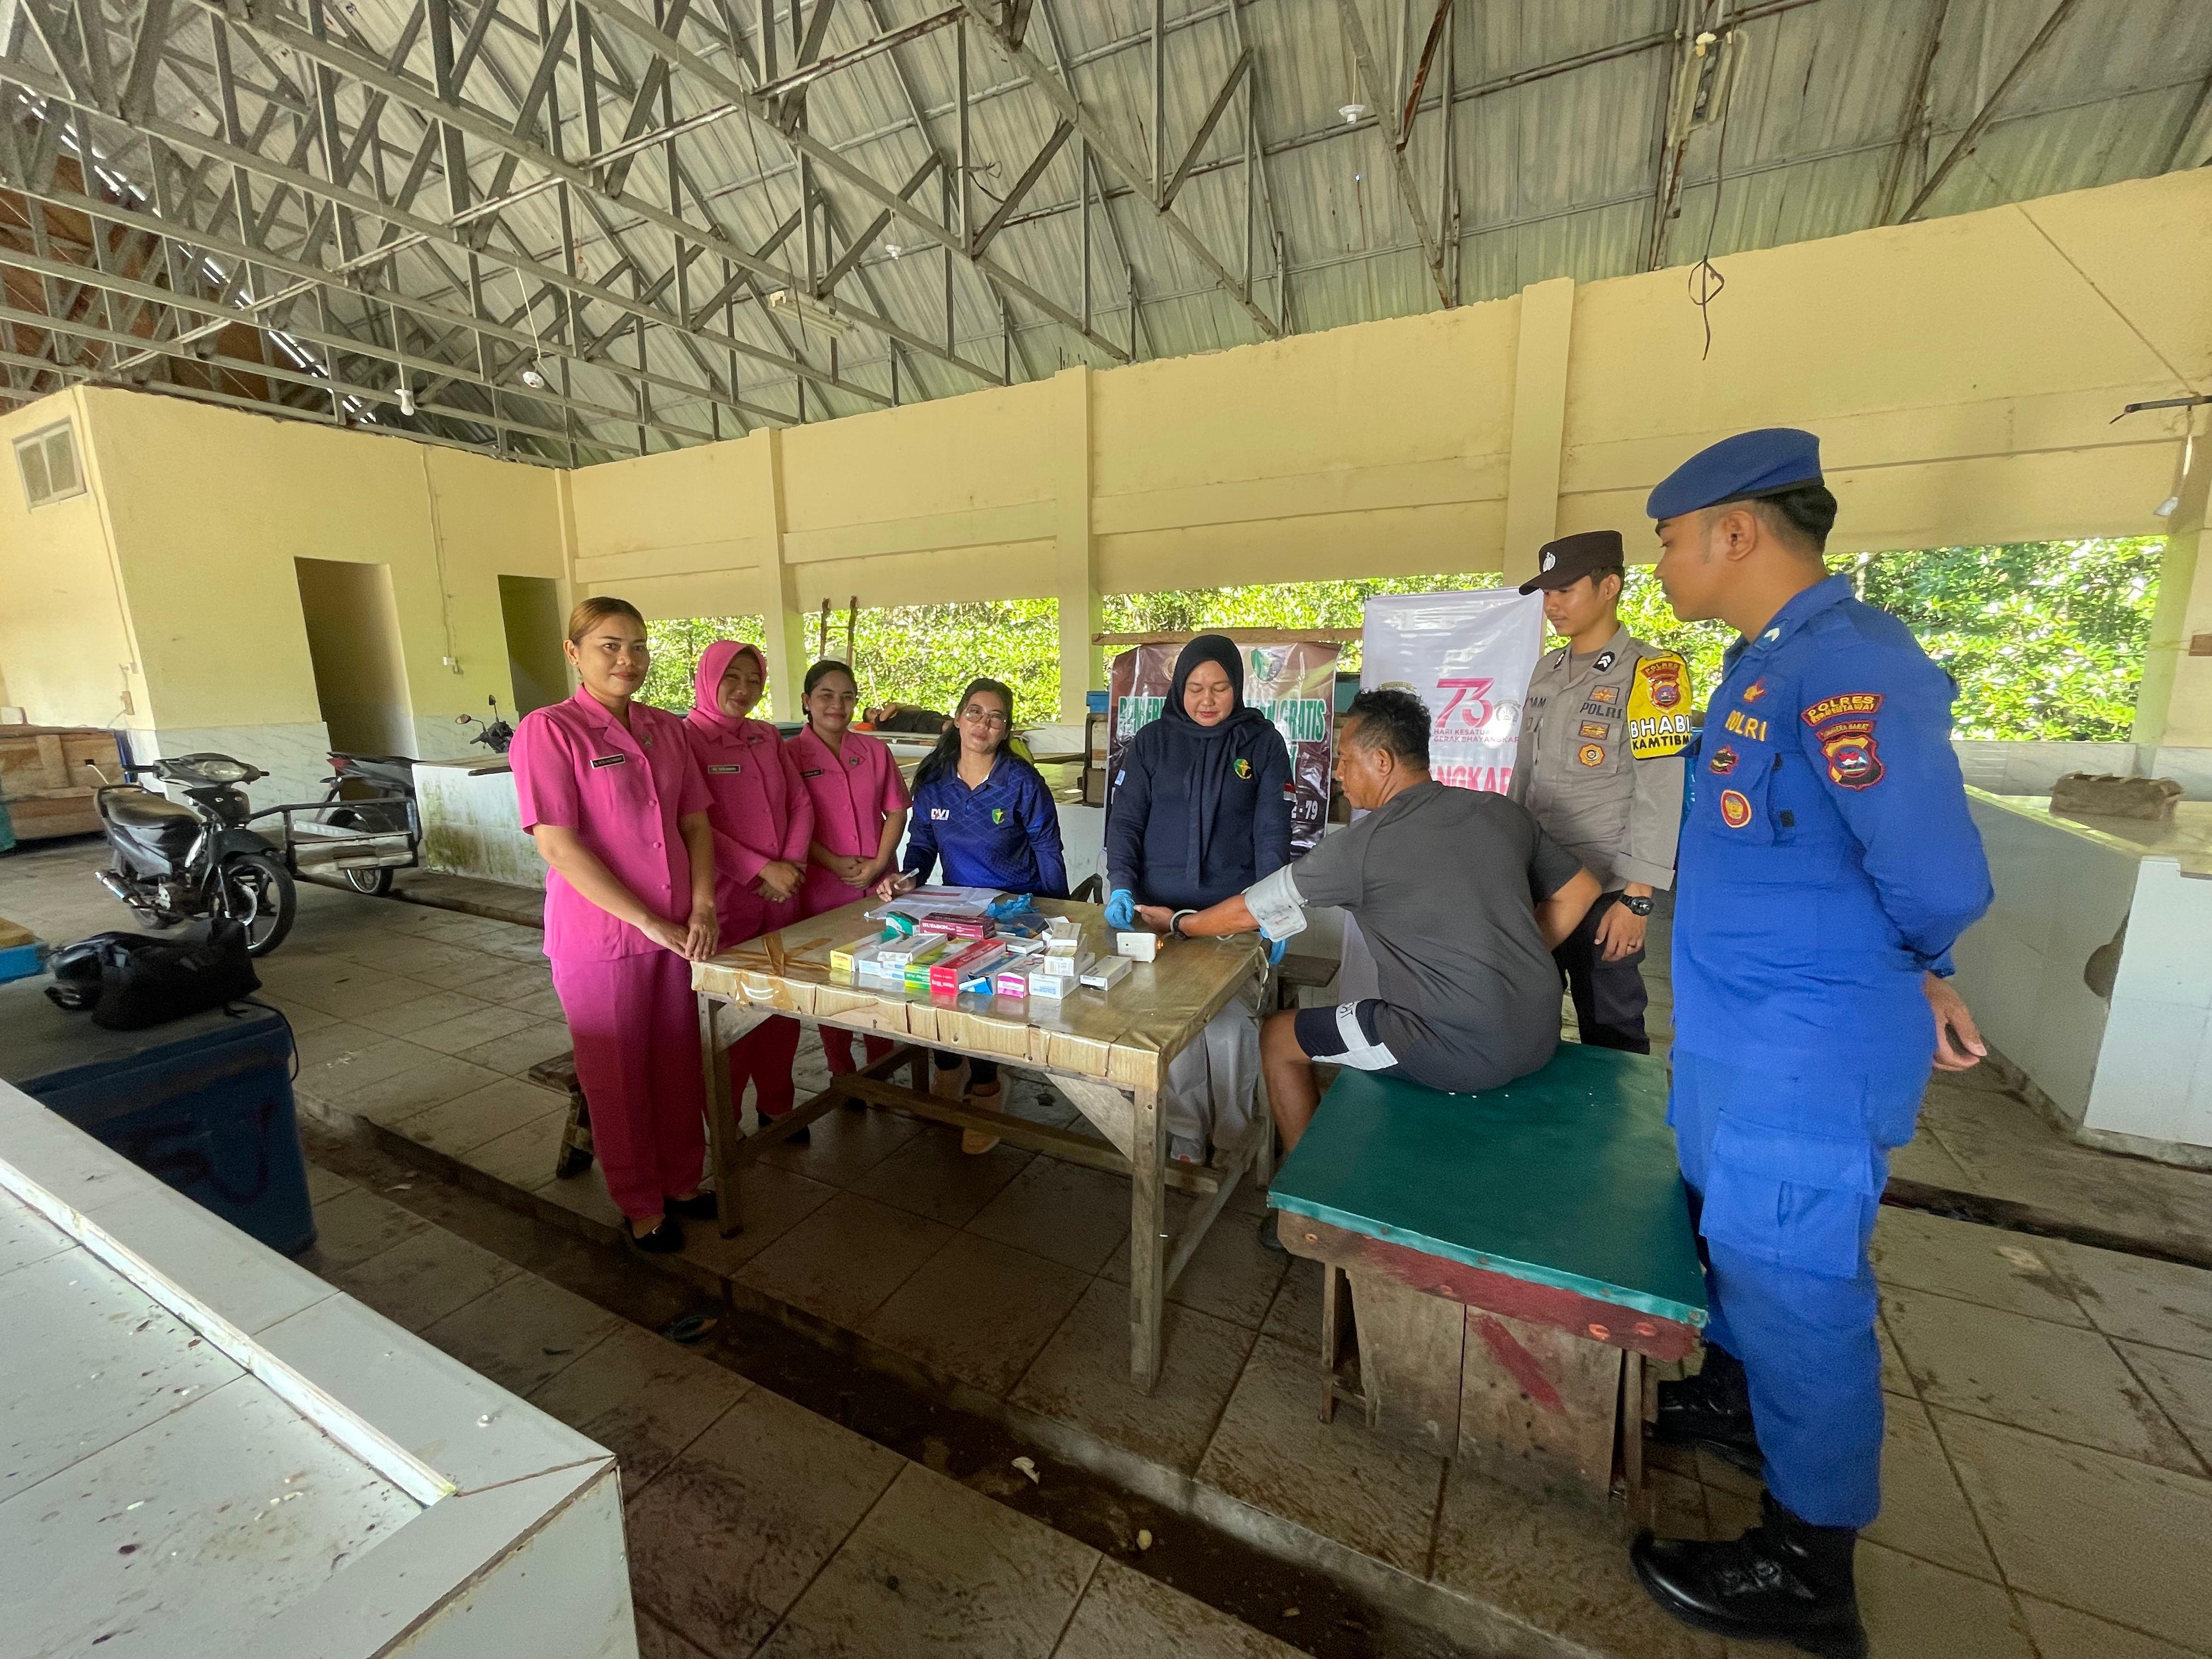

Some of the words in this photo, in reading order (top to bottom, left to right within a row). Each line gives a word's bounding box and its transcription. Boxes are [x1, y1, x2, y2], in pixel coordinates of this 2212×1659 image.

[1435, 678, 1494, 728] 73
[1579, 702, 1623, 719] POLRI
[1808, 696, 1875, 718] POLRES
[1429, 766, 1513, 794] NGKAR
[1305, 800, 1318, 820] 79
